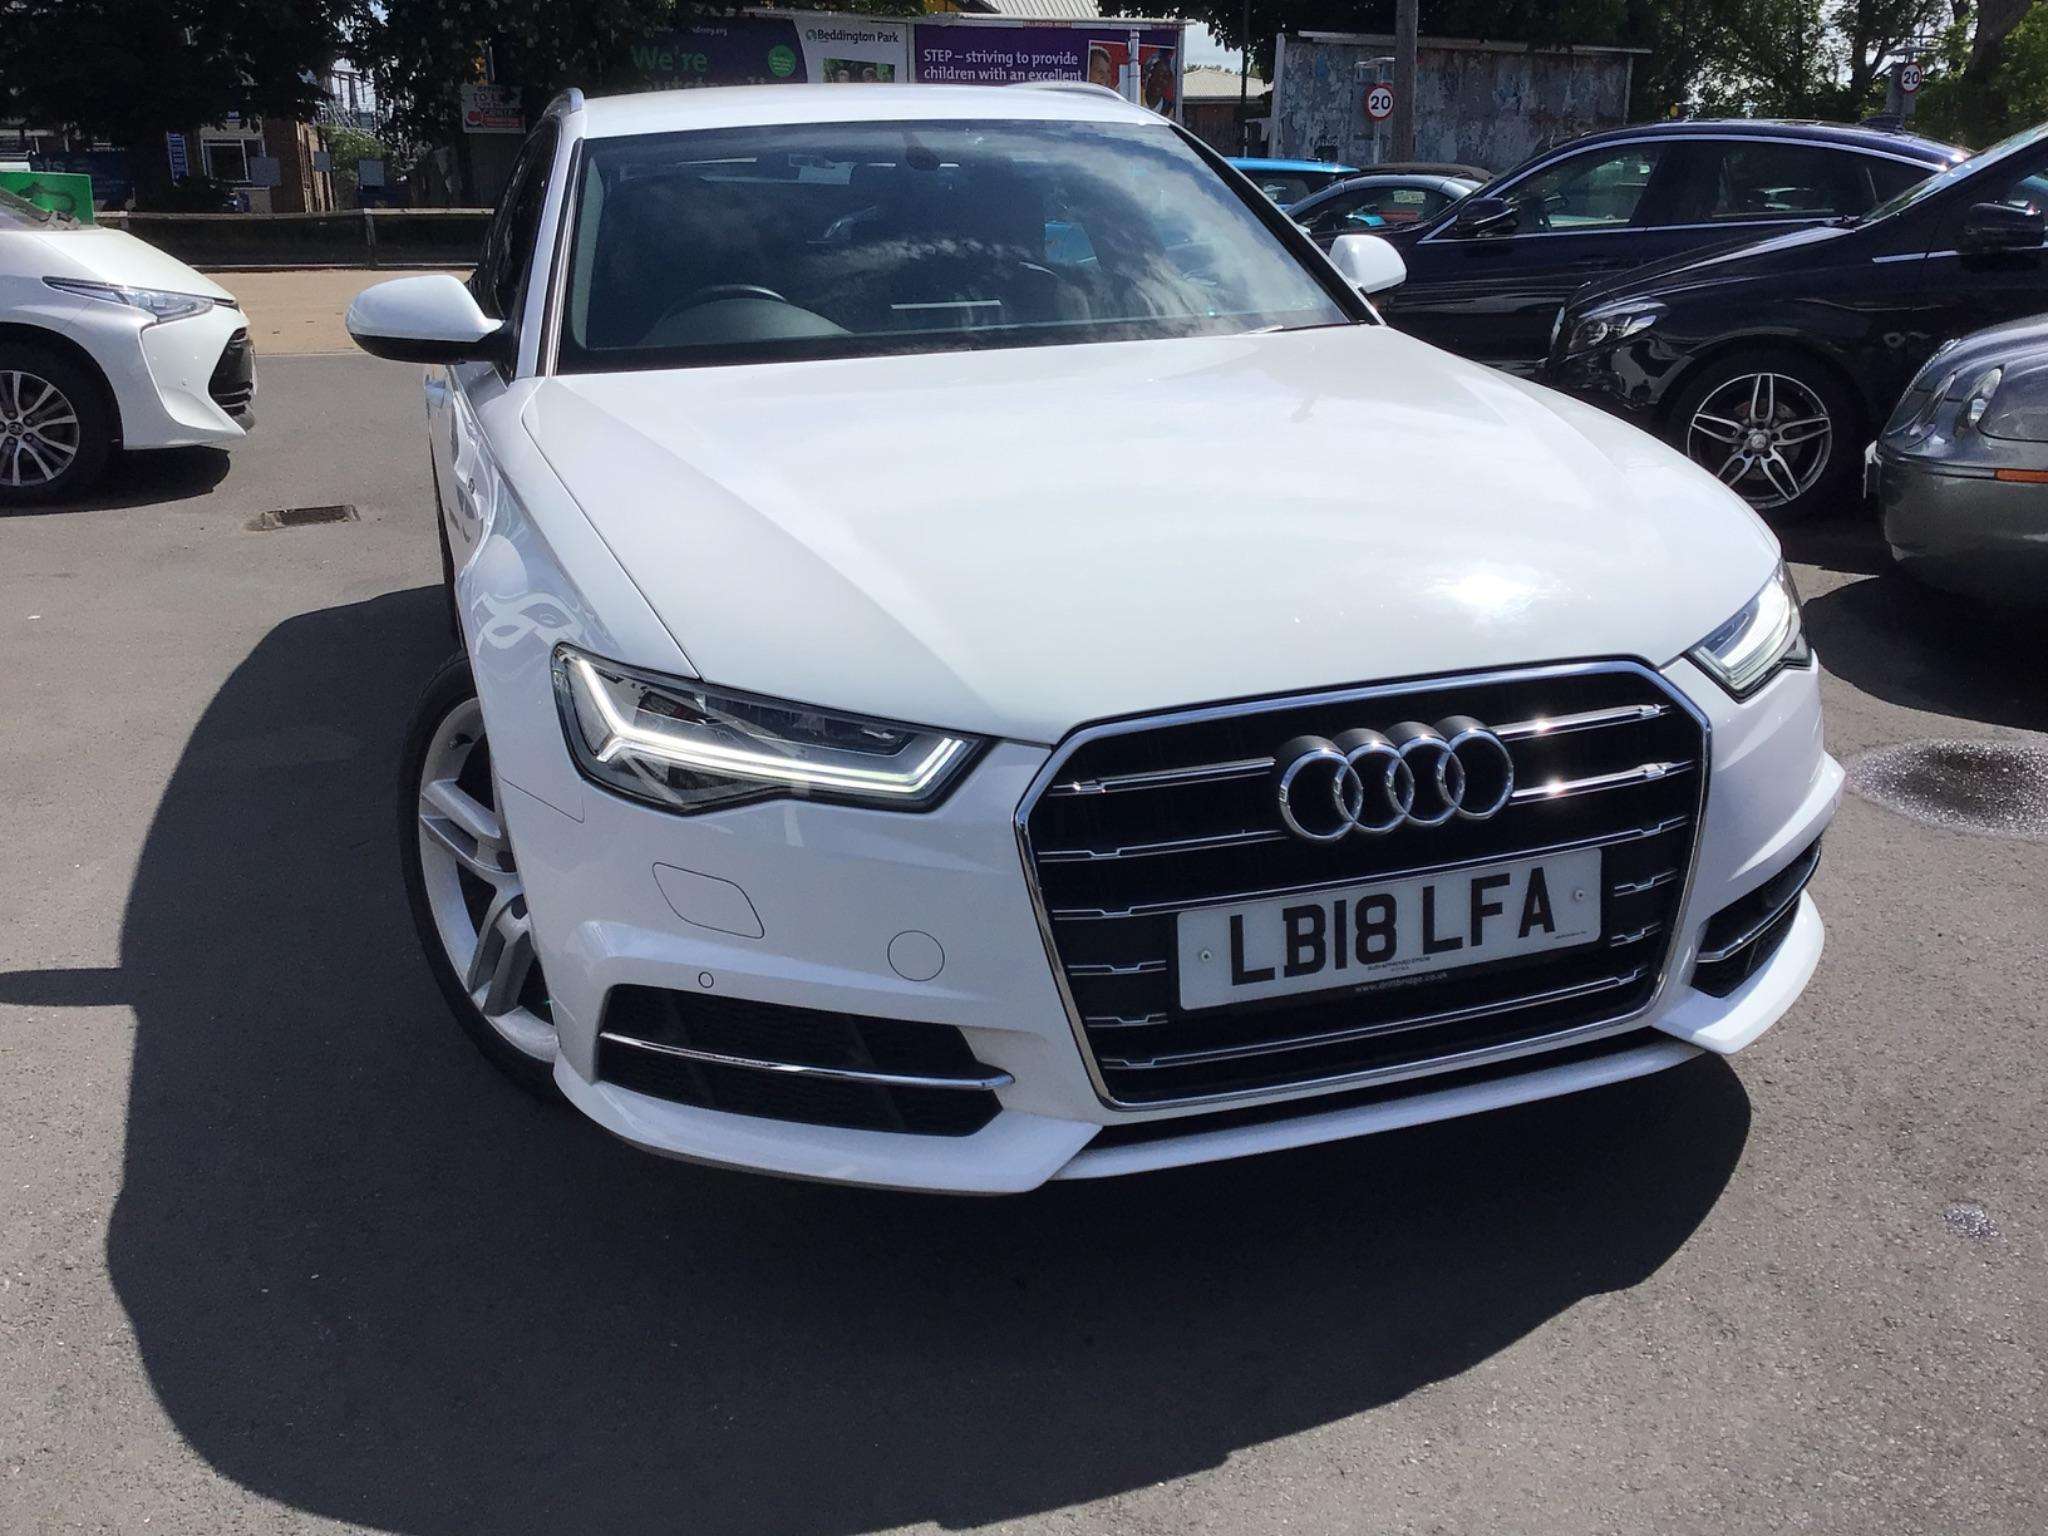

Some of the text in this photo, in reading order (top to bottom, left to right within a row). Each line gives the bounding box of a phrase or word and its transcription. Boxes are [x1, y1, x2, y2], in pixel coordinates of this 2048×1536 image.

[817, 29, 899, 44] Beddington Park
[924, 49, 952, 62] STEP
[966, 50, 1013, 67] striving
[1016, 52, 1029, 64] to
[1032, 52, 1078, 67] provide
[924, 66, 1082, 82] children with an excellent
[1904, 71, 1920, 84] 20
[1371, 95, 1391, 110] 20
[1230, 866, 1556, 986] LB18 LFA
